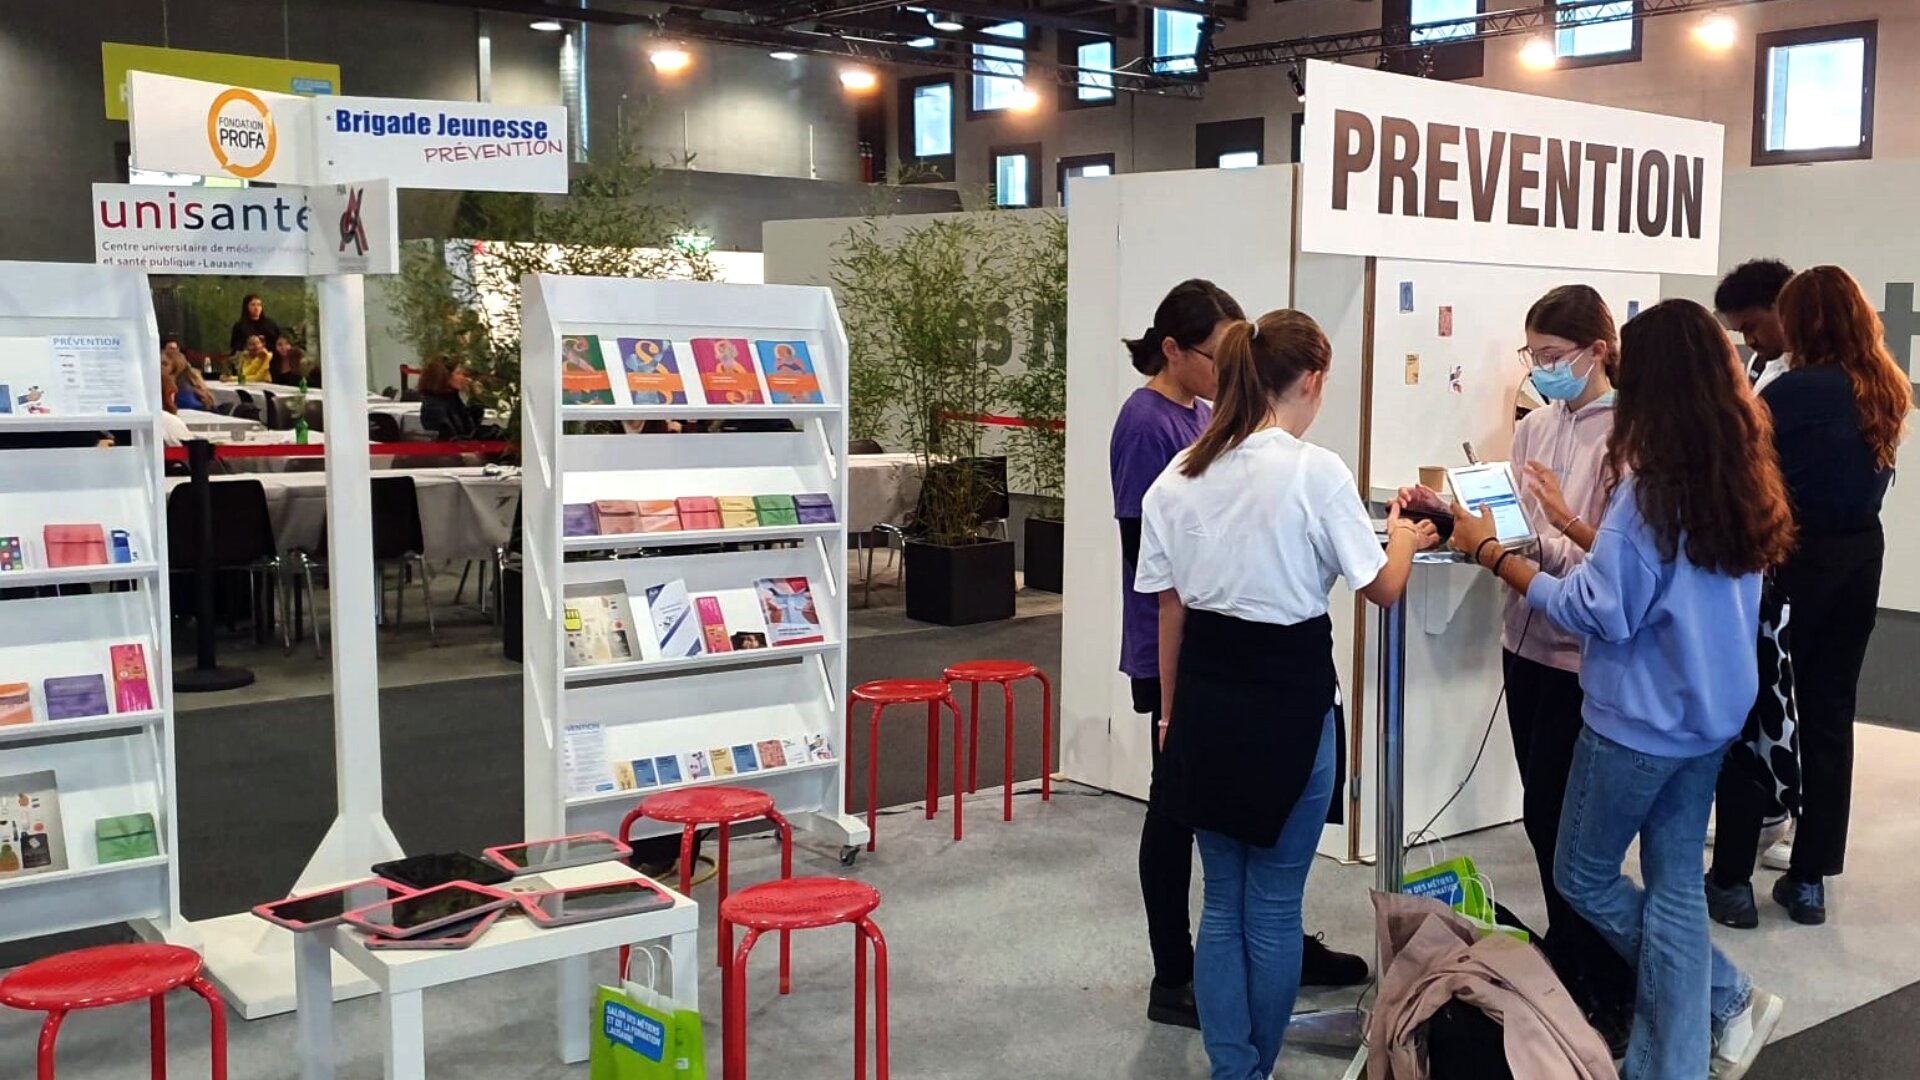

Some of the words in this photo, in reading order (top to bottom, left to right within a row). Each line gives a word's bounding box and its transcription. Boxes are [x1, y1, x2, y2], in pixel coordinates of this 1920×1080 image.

[218, 116, 264, 130] FONDATION
[335, 109, 431, 136] Brigade
[437, 113, 548, 140] Jeunesse
[220, 128, 266, 150] PROFA
[424, 139, 563, 163] PRÉVENTION
[1331, 109, 1704, 239] PREVENTION
[102, 241, 139, 252] Centre
[142, 242, 207, 253] universitaire
[210, 244, 223, 253] de
[103, 257, 114, 265] et
[117, 257, 148, 266] santé
[150, 258, 195, 270] publique
